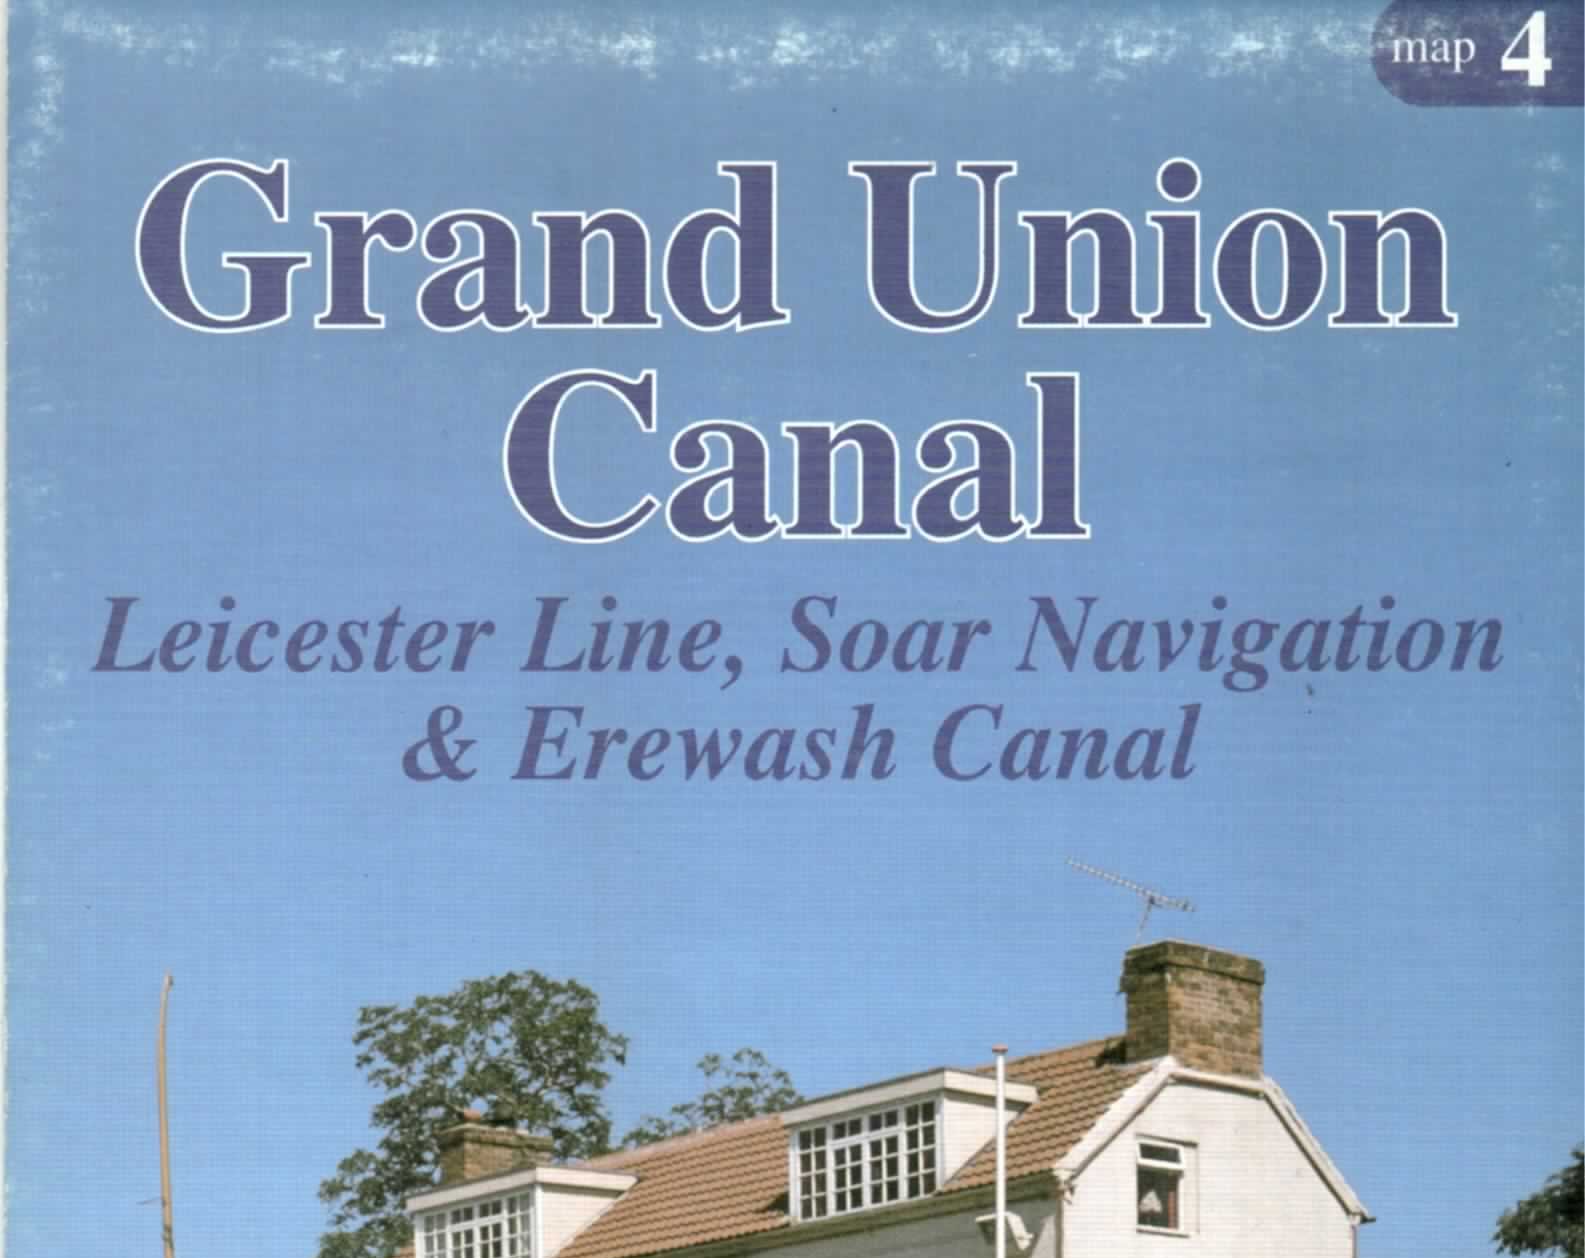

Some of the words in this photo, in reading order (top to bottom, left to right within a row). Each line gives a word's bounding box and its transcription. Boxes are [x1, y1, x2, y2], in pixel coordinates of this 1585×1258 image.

[1391, 31, 1477, 73] map
[1500, 9, 1553, 87] 4
[134, 157, 790, 333] Grand
[848, 156, 1458, 333] Union
[503, 368, 1090, 543] Canal
[91, 596, 495, 674] Leicester
[520, 596, 743, 690] Line,
[780, 594, 990, 674] Soar
[1016, 595, 1504, 693] Navigation
[401, 703, 480, 783] &
[511, 703, 895, 783] Erewash
[932, 702, 1203, 783] Canal
